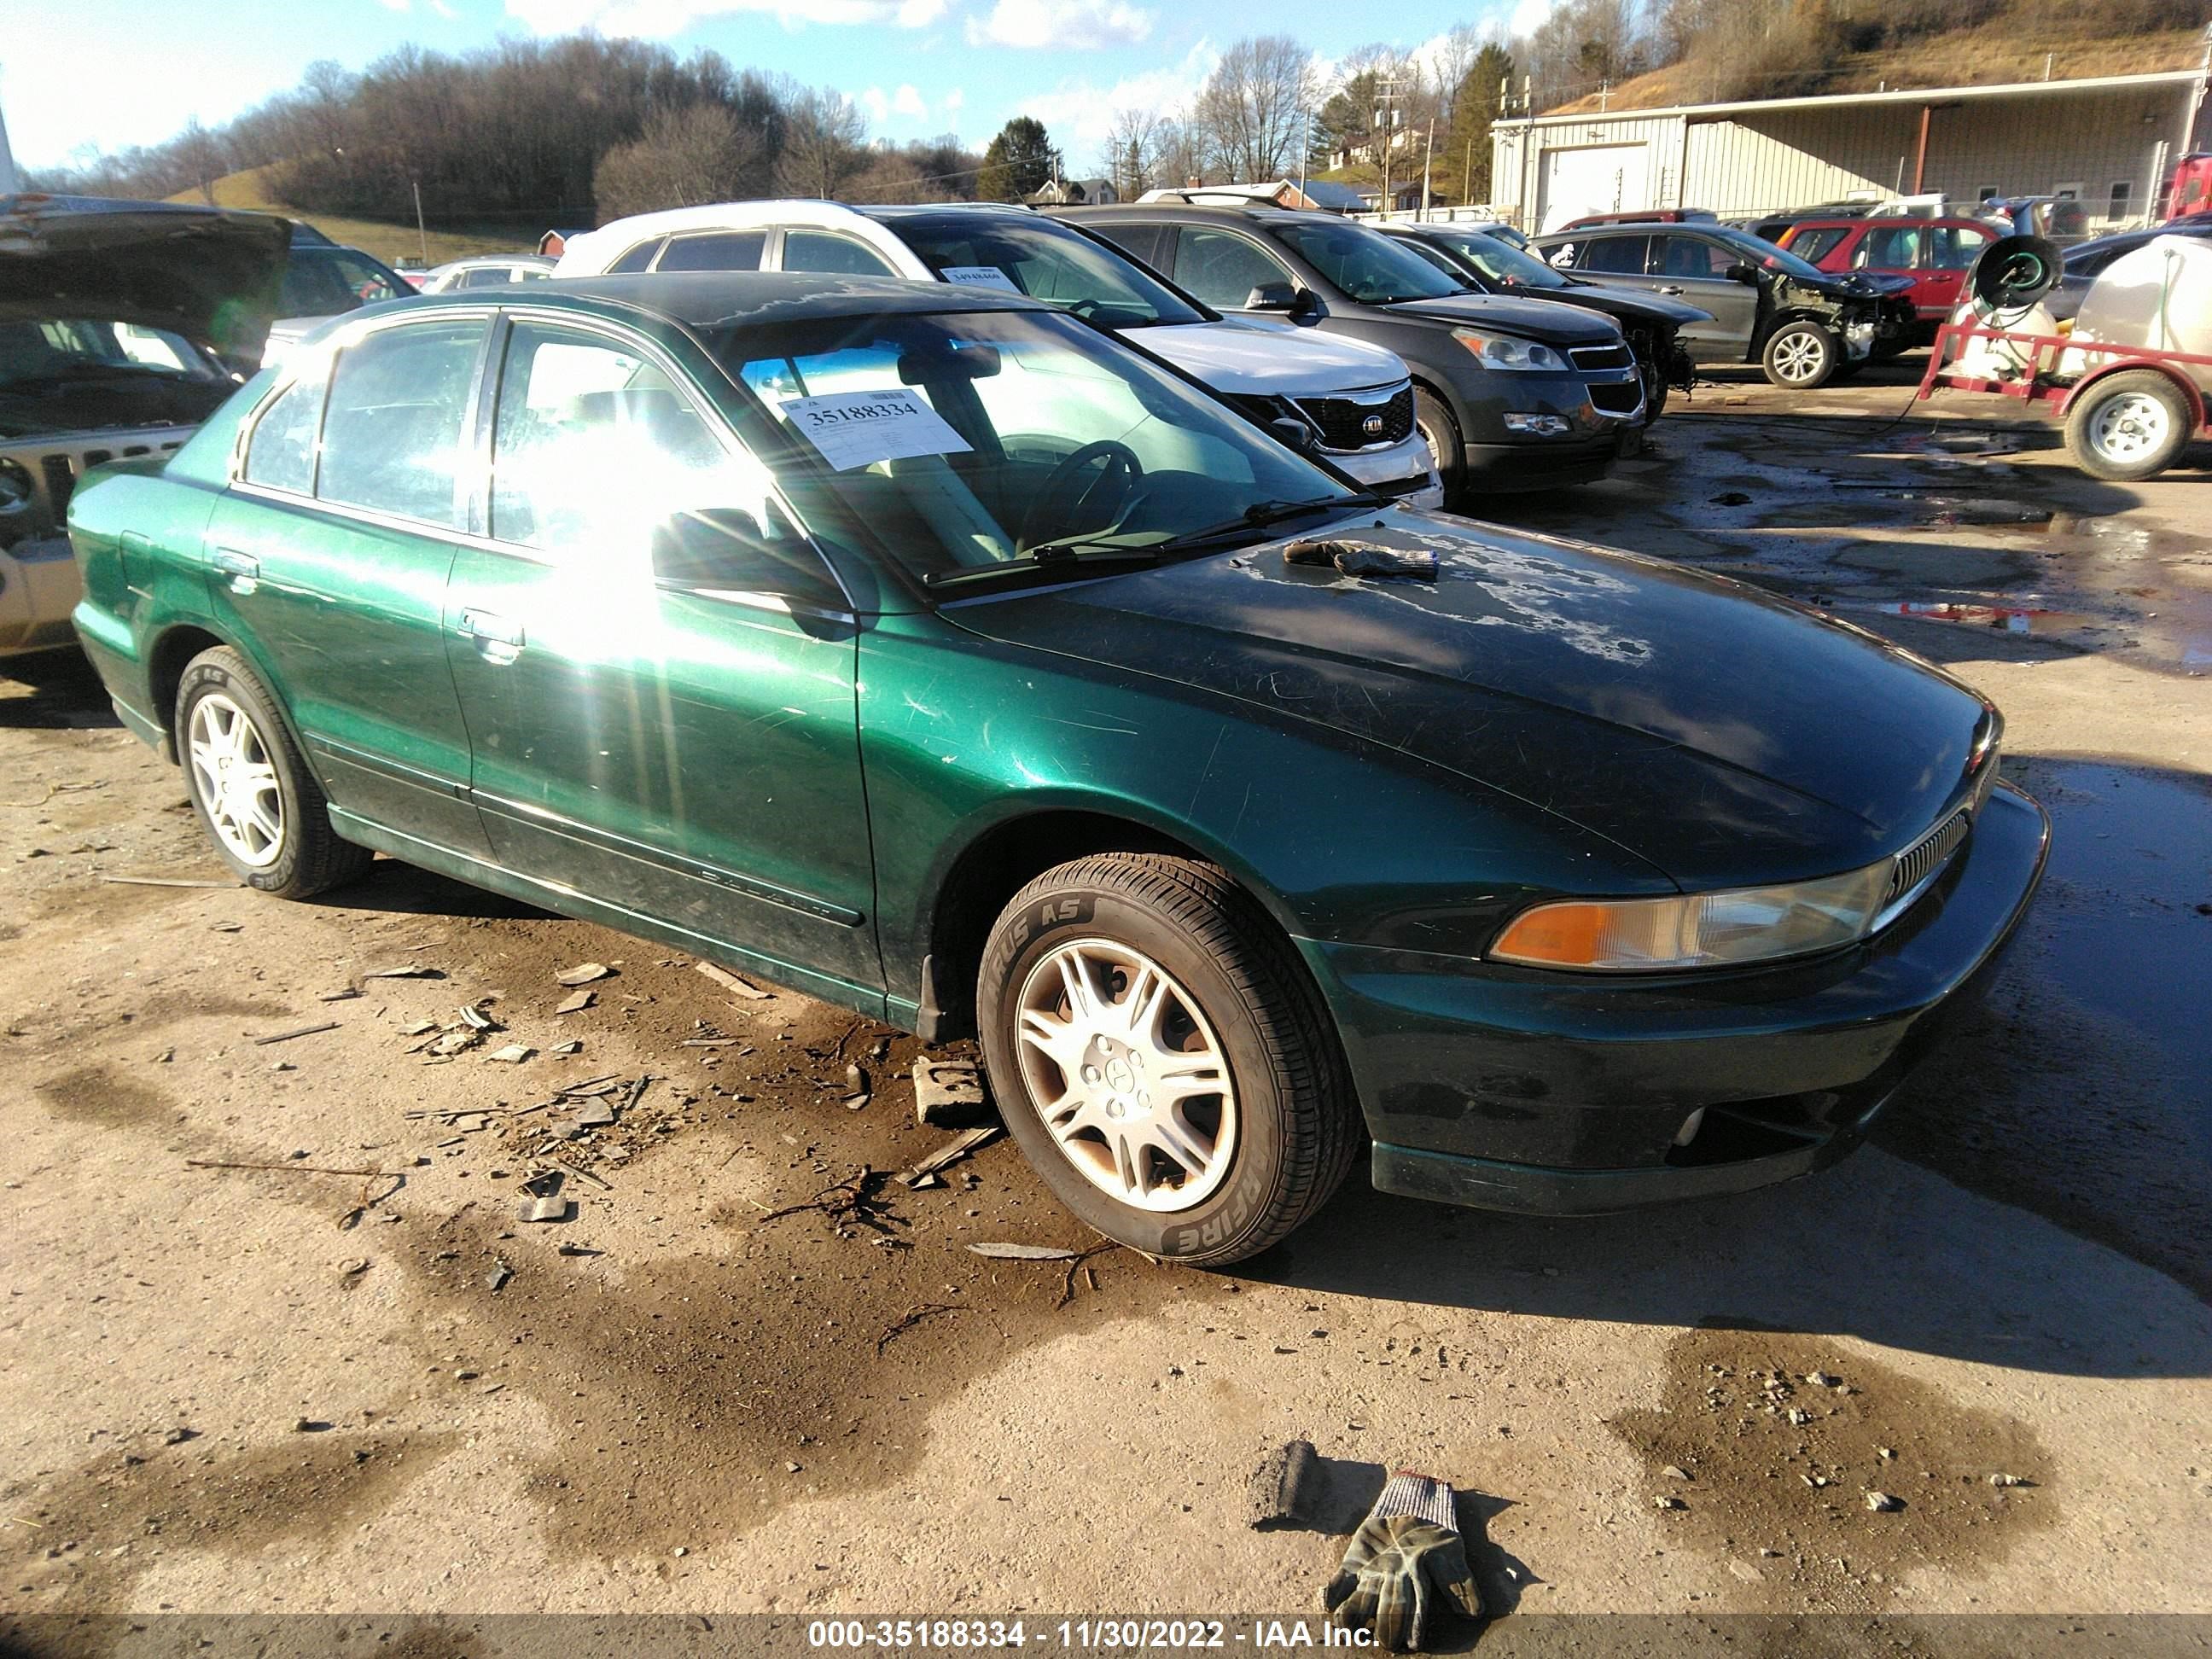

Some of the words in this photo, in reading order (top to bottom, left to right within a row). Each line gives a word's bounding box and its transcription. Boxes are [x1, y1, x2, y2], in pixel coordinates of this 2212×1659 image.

[806, 403, 918, 426] 35188334
[1367, 419, 1382, 431] KIA
[1042, 899, 1080, 926] AS
